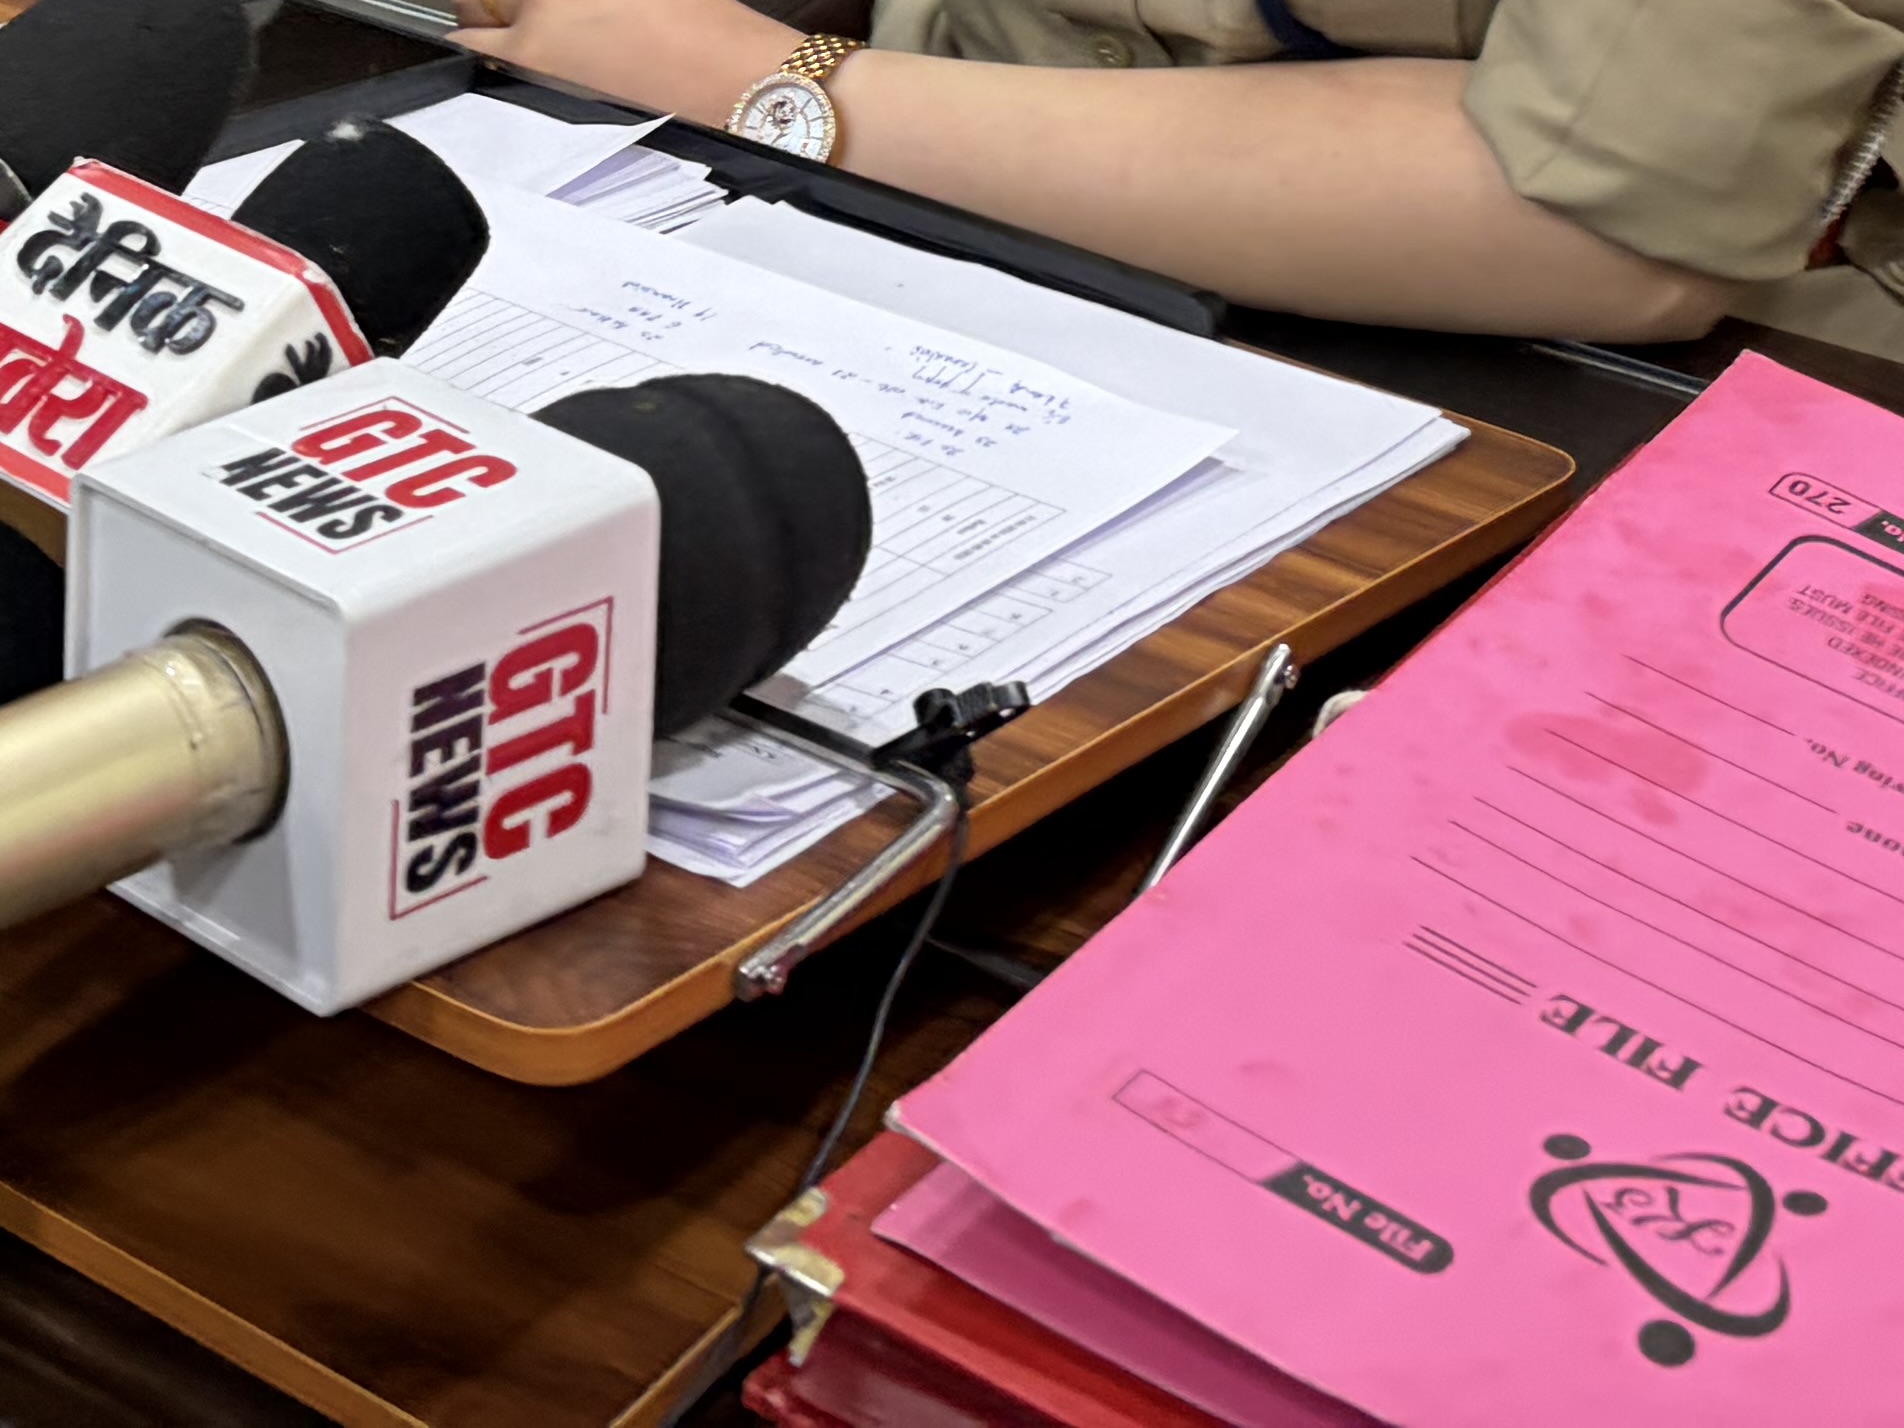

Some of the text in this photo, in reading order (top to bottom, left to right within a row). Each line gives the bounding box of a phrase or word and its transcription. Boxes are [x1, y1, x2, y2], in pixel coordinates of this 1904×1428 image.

[16, 192, 246, 363] दैनिक
[221, 448, 408, 544] NEWS
[292, 408, 518, 510] GTC
[1788, 480, 1851, 515] 270
[1796, 583, 1854, 614] MUST
[1854, 609, 1895, 634] FILE
[404, 662, 487, 896] NEWS
[482, 622, 601, 861] GTC
[1805, 738, 1850, 768] No.
[1540, 994, 1705, 1092] FILE
[1303, 1174, 1434, 1262] File No.
